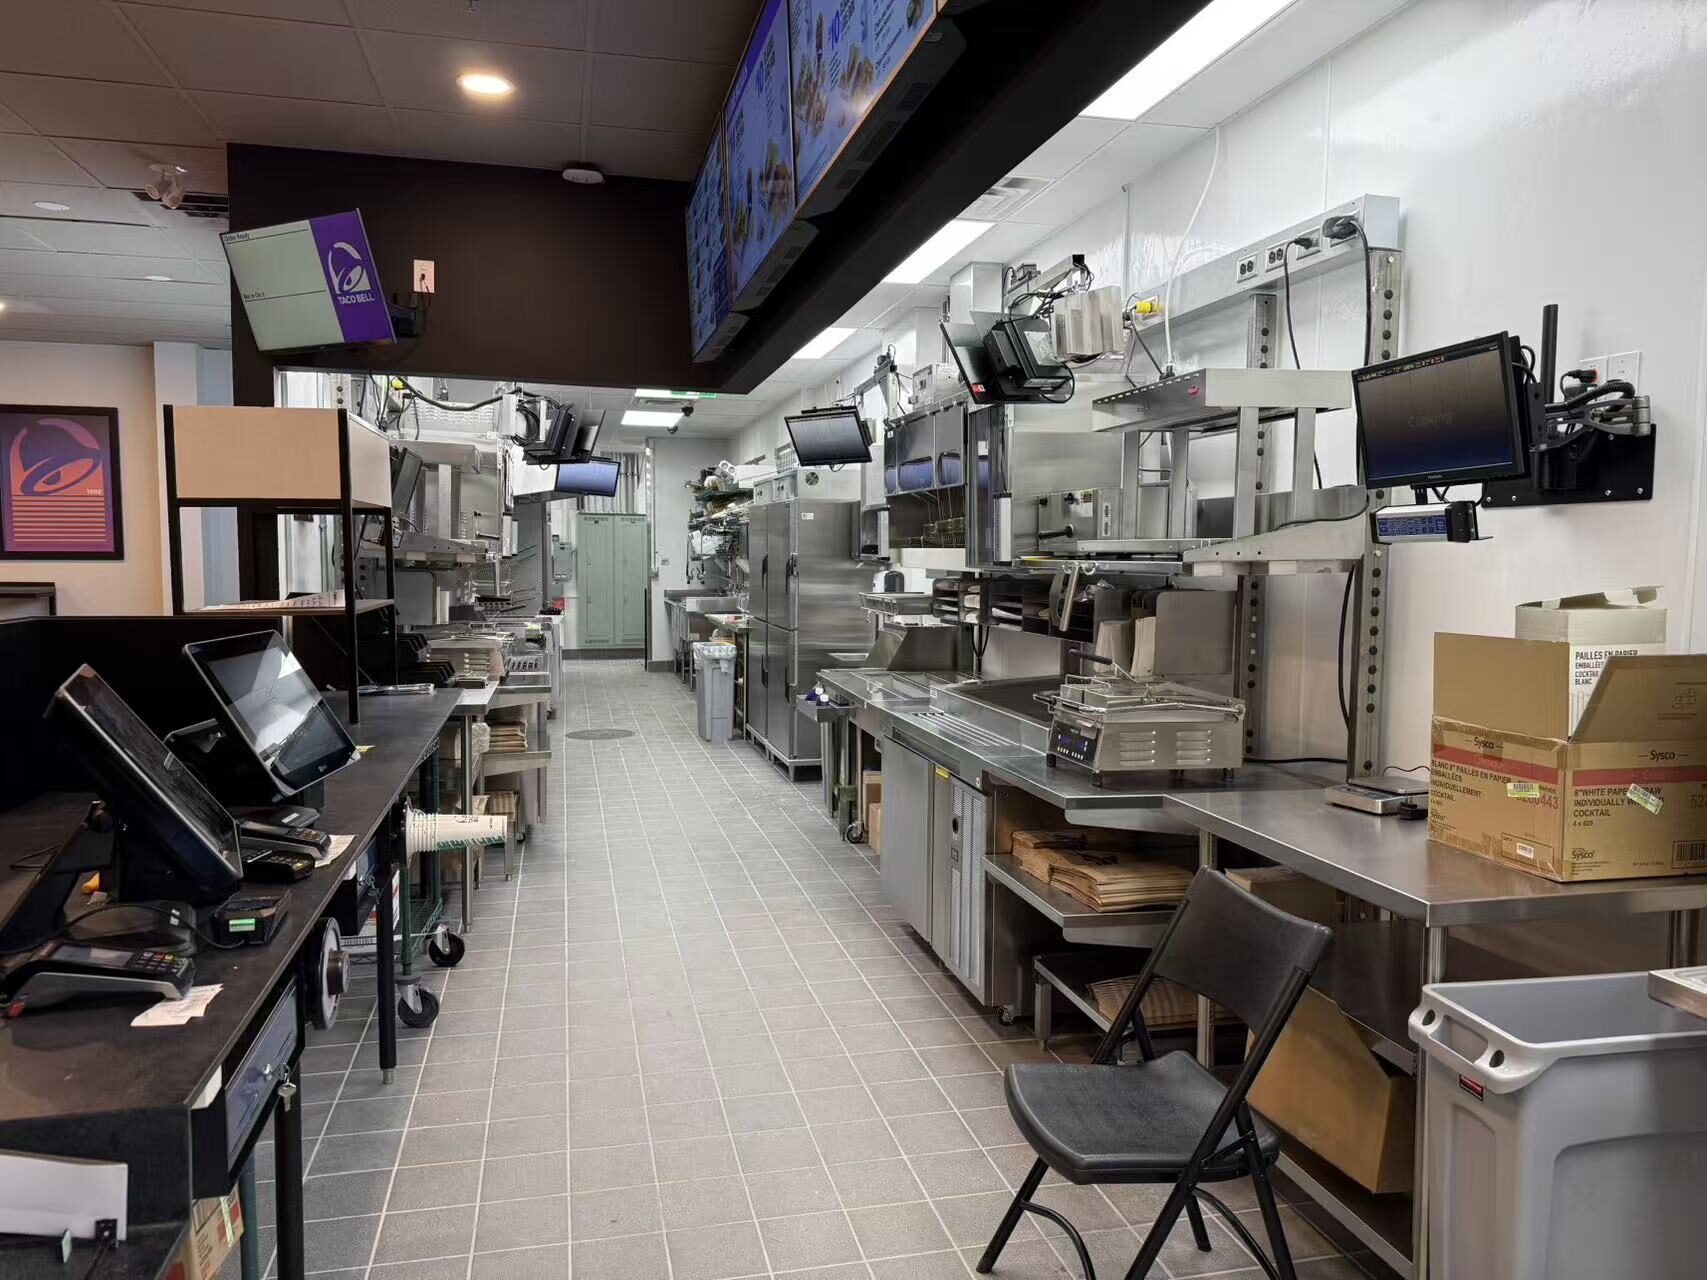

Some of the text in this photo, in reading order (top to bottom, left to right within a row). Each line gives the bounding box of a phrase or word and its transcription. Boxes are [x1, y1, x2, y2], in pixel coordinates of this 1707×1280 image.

[337, 293, 375, 305] TACO BELL
[1575, 651, 1603, 661] PAILLES
[1575, 678, 1592, 686] BLANC
[1474, 736, 1494, 749] Sysco
[1650, 749, 1675, 762] Sysco
[1431, 759, 1449, 770] BLANC
[1456, 764, 1479, 777] PAILLES
[1480, 771, 1489, 779] EN
[1489, 773, 1512, 785] PAPIER
[1430, 789, 1456, 802] COCKTAIL
[1607, 787, 1629, 796] PAPE
[1574, 798, 1625, 808] INDIVIDUALLY
[1573, 808, 1612, 818] COCKTAIL
[1572, 850, 1594, 860] Sysco
